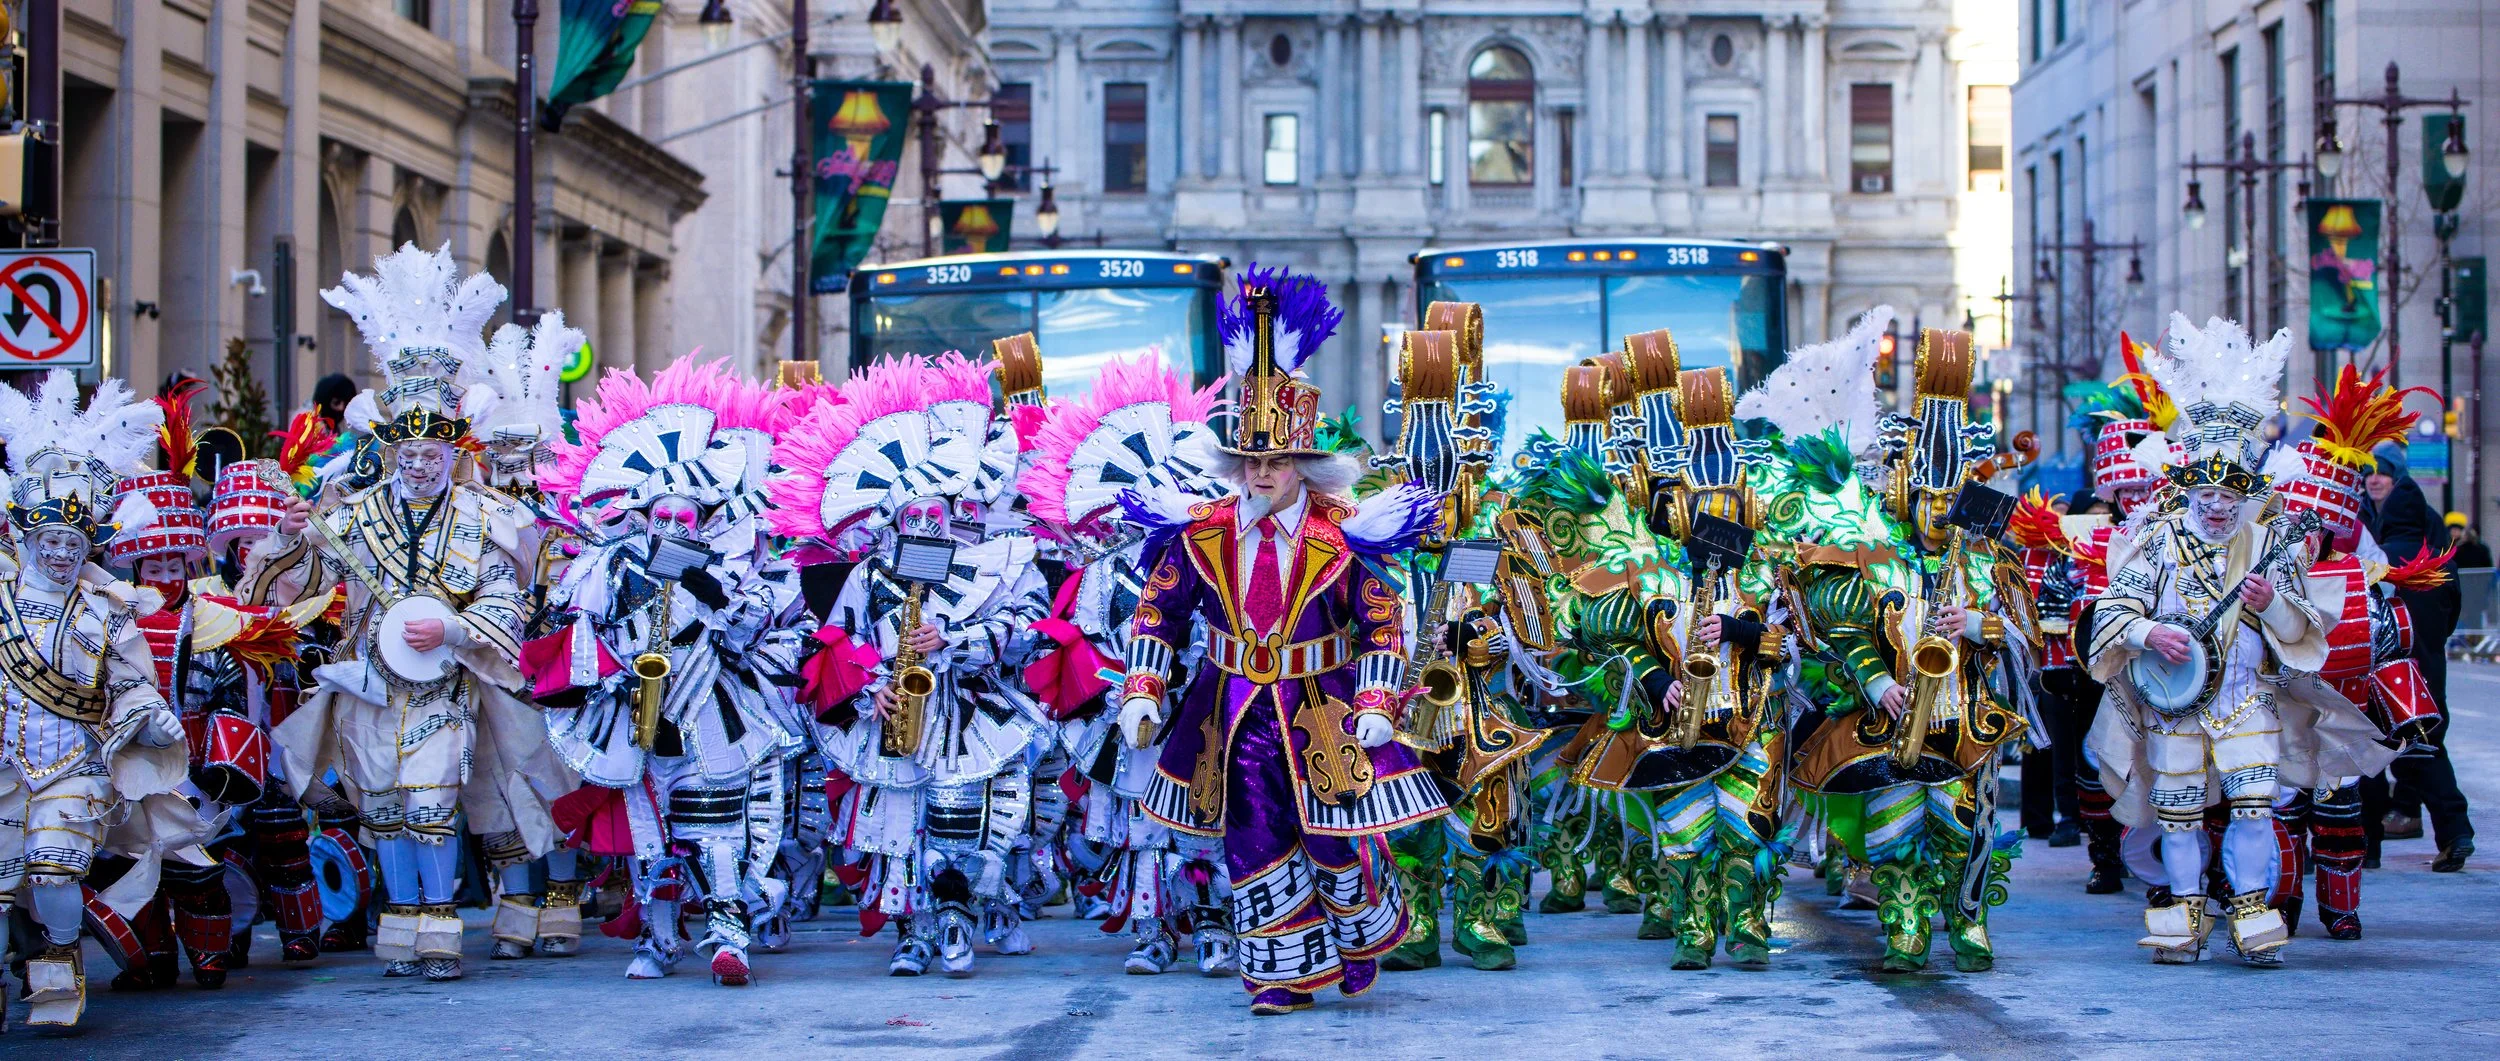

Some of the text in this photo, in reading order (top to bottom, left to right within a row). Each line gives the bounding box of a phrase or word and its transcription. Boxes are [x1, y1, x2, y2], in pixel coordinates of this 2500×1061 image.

[1496, 249, 1539, 268] 3518
[1667, 247, 1710, 265] 3518
[926, 264, 972, 285] 3520
[1099, 259, 1145, 278] 3520
